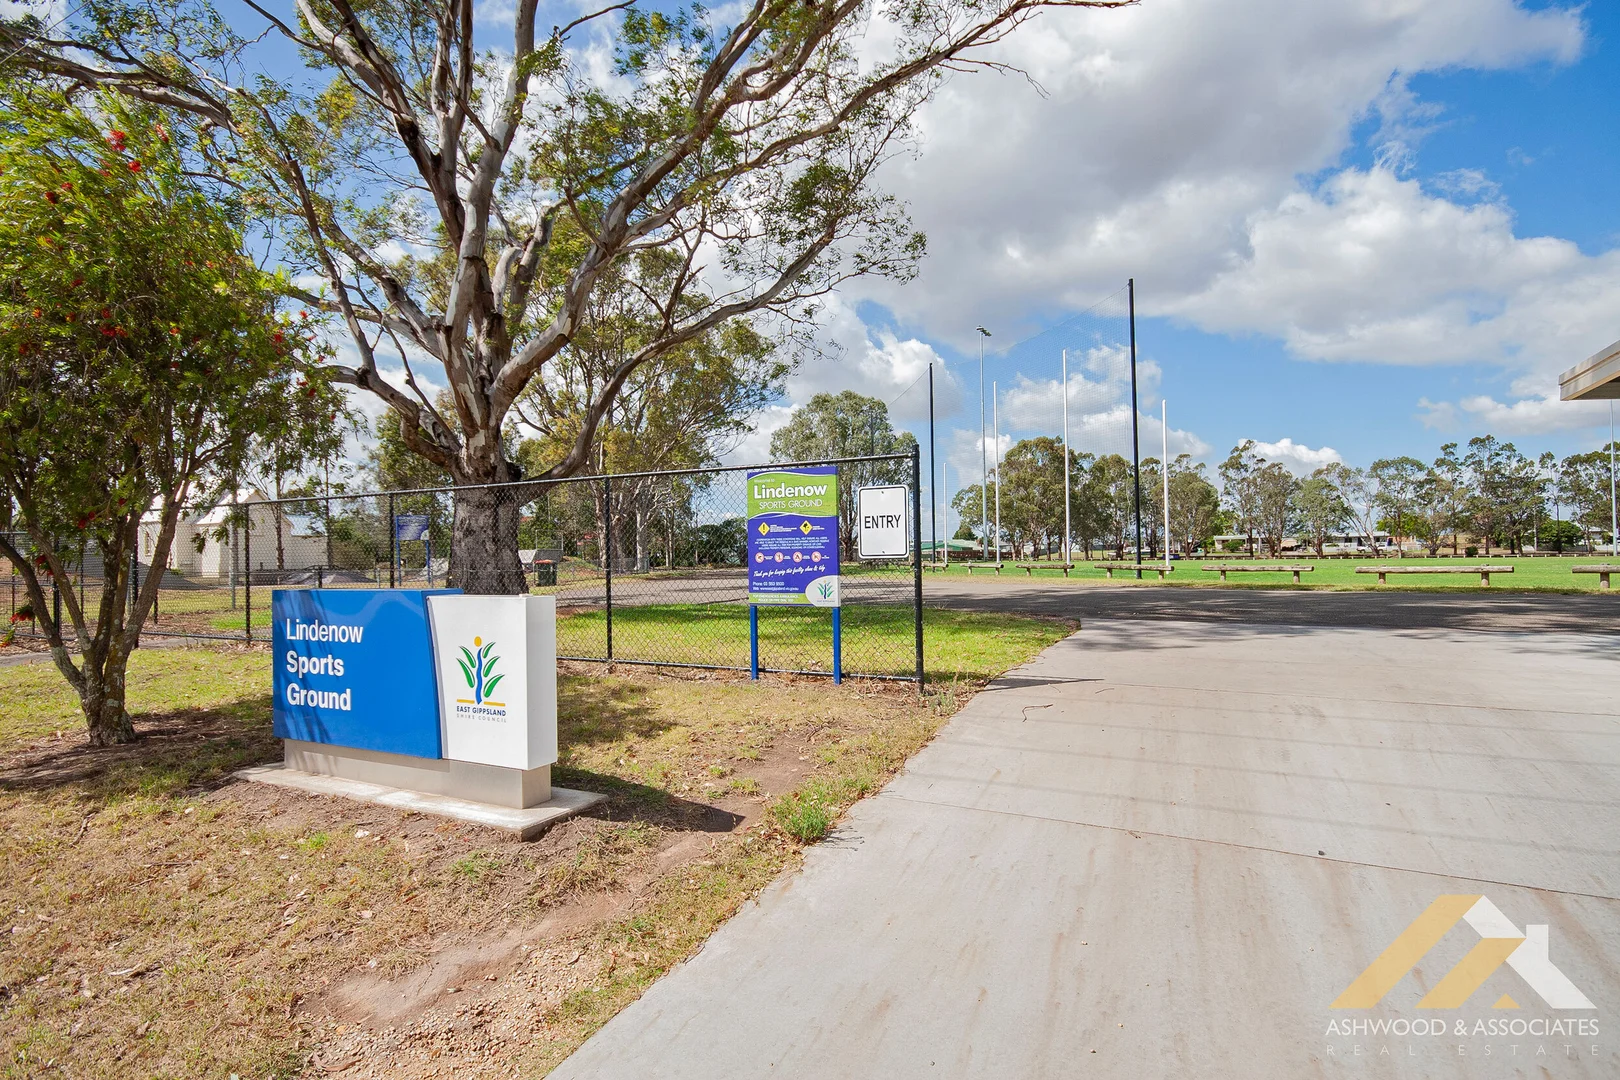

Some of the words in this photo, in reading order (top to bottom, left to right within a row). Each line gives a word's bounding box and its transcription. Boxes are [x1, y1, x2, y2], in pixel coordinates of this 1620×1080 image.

[754, 482, 828, 499] Lindenow
[760, 500, 786, 510] SPORTS
[788, 499, 823, 508] GROUND
[864, 514, 901, 529] ENTRY
[286, 618, 363, 643] Lindenow
[286, 650, 344, 678] Sports
[286, 682, 351, 711] Ground
[456, 705, 470, 713] EAST
[472, 707, 506, 716] GIPPSLAND
[478, 715, 506, 723] COUNCIL
